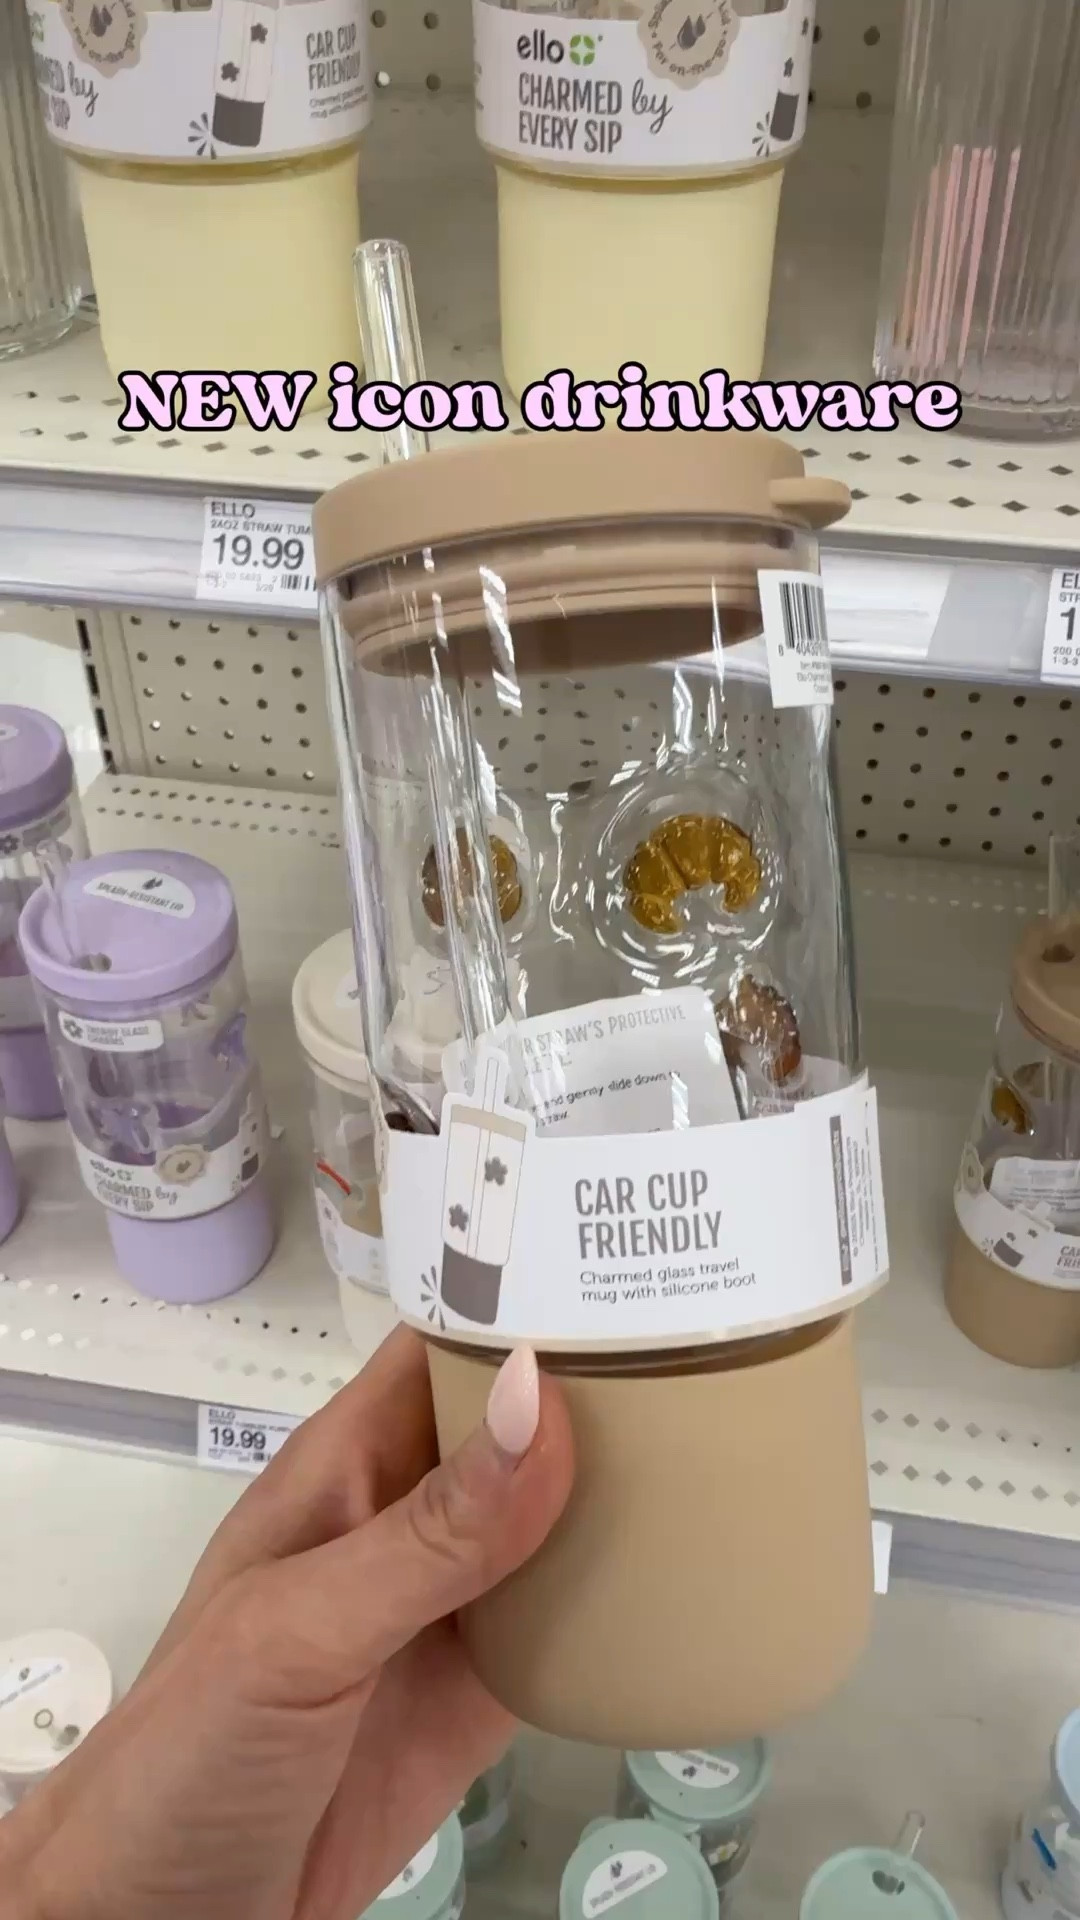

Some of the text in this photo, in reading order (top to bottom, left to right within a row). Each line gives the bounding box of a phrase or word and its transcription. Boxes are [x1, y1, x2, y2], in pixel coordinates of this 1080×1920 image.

[306, 22, 357, 59] CAR CUP
[516, 28, 565, 65] ello
[518, 71, 674, 135] CHARMED by
[518, 109, 623, 154] EVERY SIP
[211, 501, 256, 519] ELLO
[242, 521, 284, 533] STRAW
[213, 533, 304, 571] 19.99
[608, 1004, 687, 1035] PROTECTIVE
[608, 1078, 633, 1092] slide
[635, 1072, 668, 1086] down
[575, 1169, 709, 1217] CAR CUP
[578, 1211, 722, 1260] FRIENDLY
[580, 1257, 740, 1285] Charmed glass travel
[582, 1272, 757, 1304] mug with silicone boot
[210, 1426, 267, 1450] 19.99
